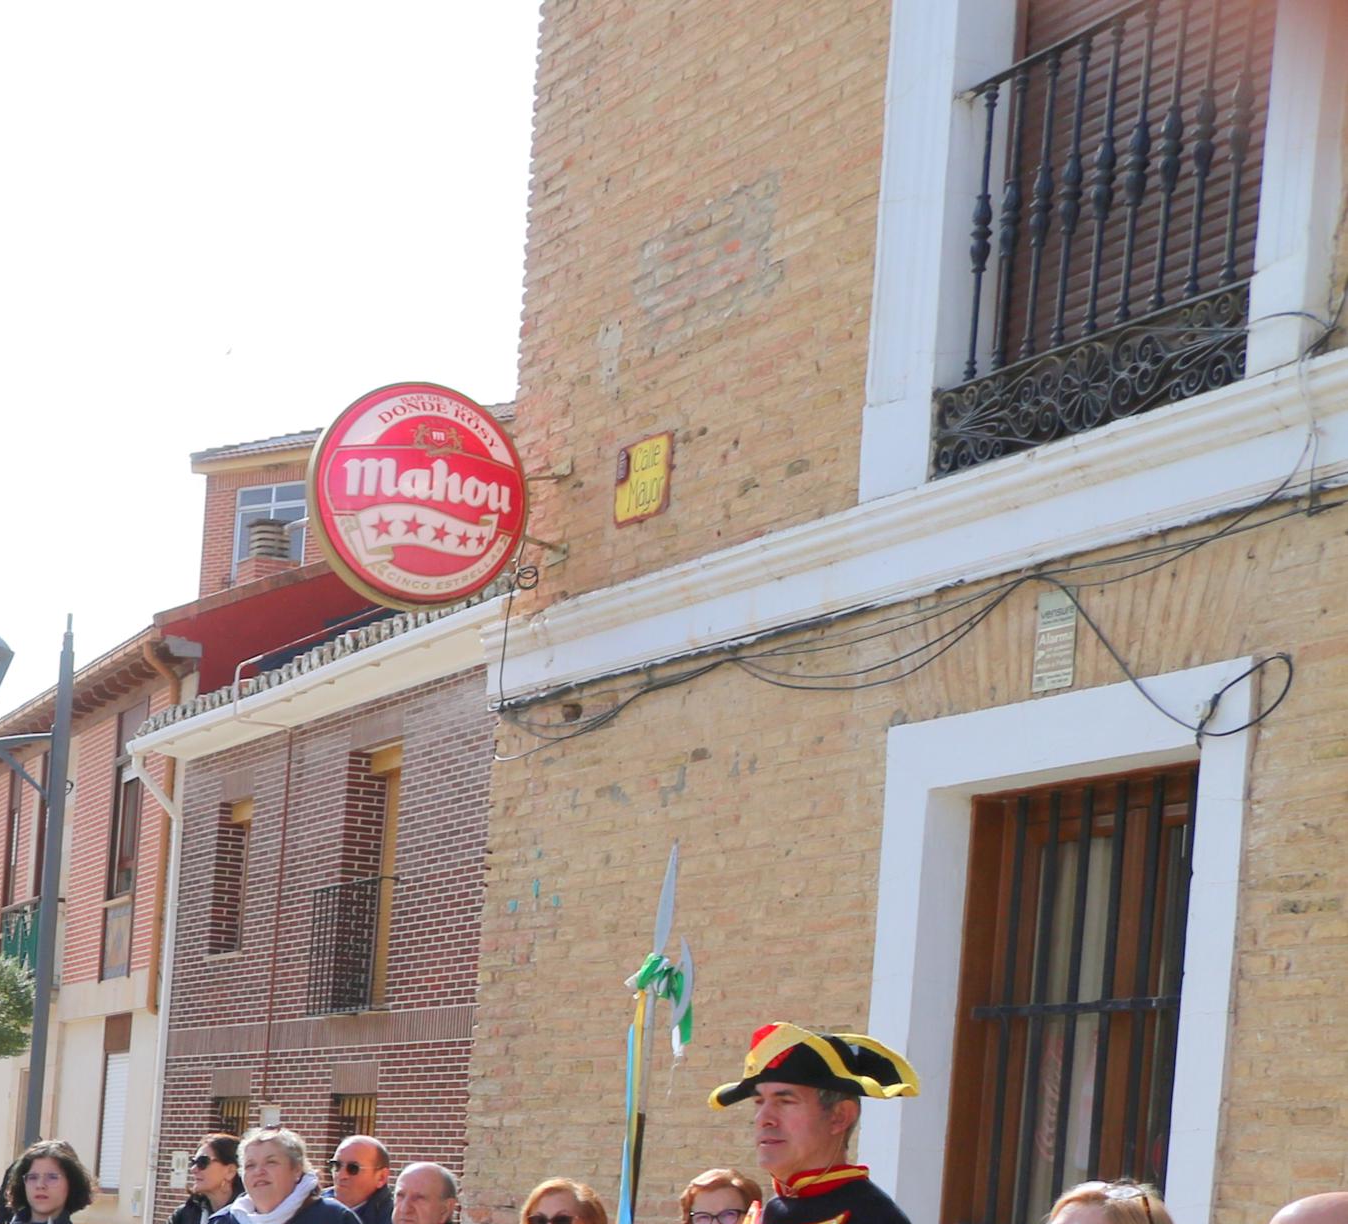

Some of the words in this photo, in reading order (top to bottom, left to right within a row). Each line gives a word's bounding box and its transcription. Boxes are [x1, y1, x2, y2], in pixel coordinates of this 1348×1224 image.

[377, 401, 448, 424] DONDE
[633, 443, 662, 473] Calle
[626, 475, 665, 513] Mayor
[387, 570, 431, 591] CINCO
